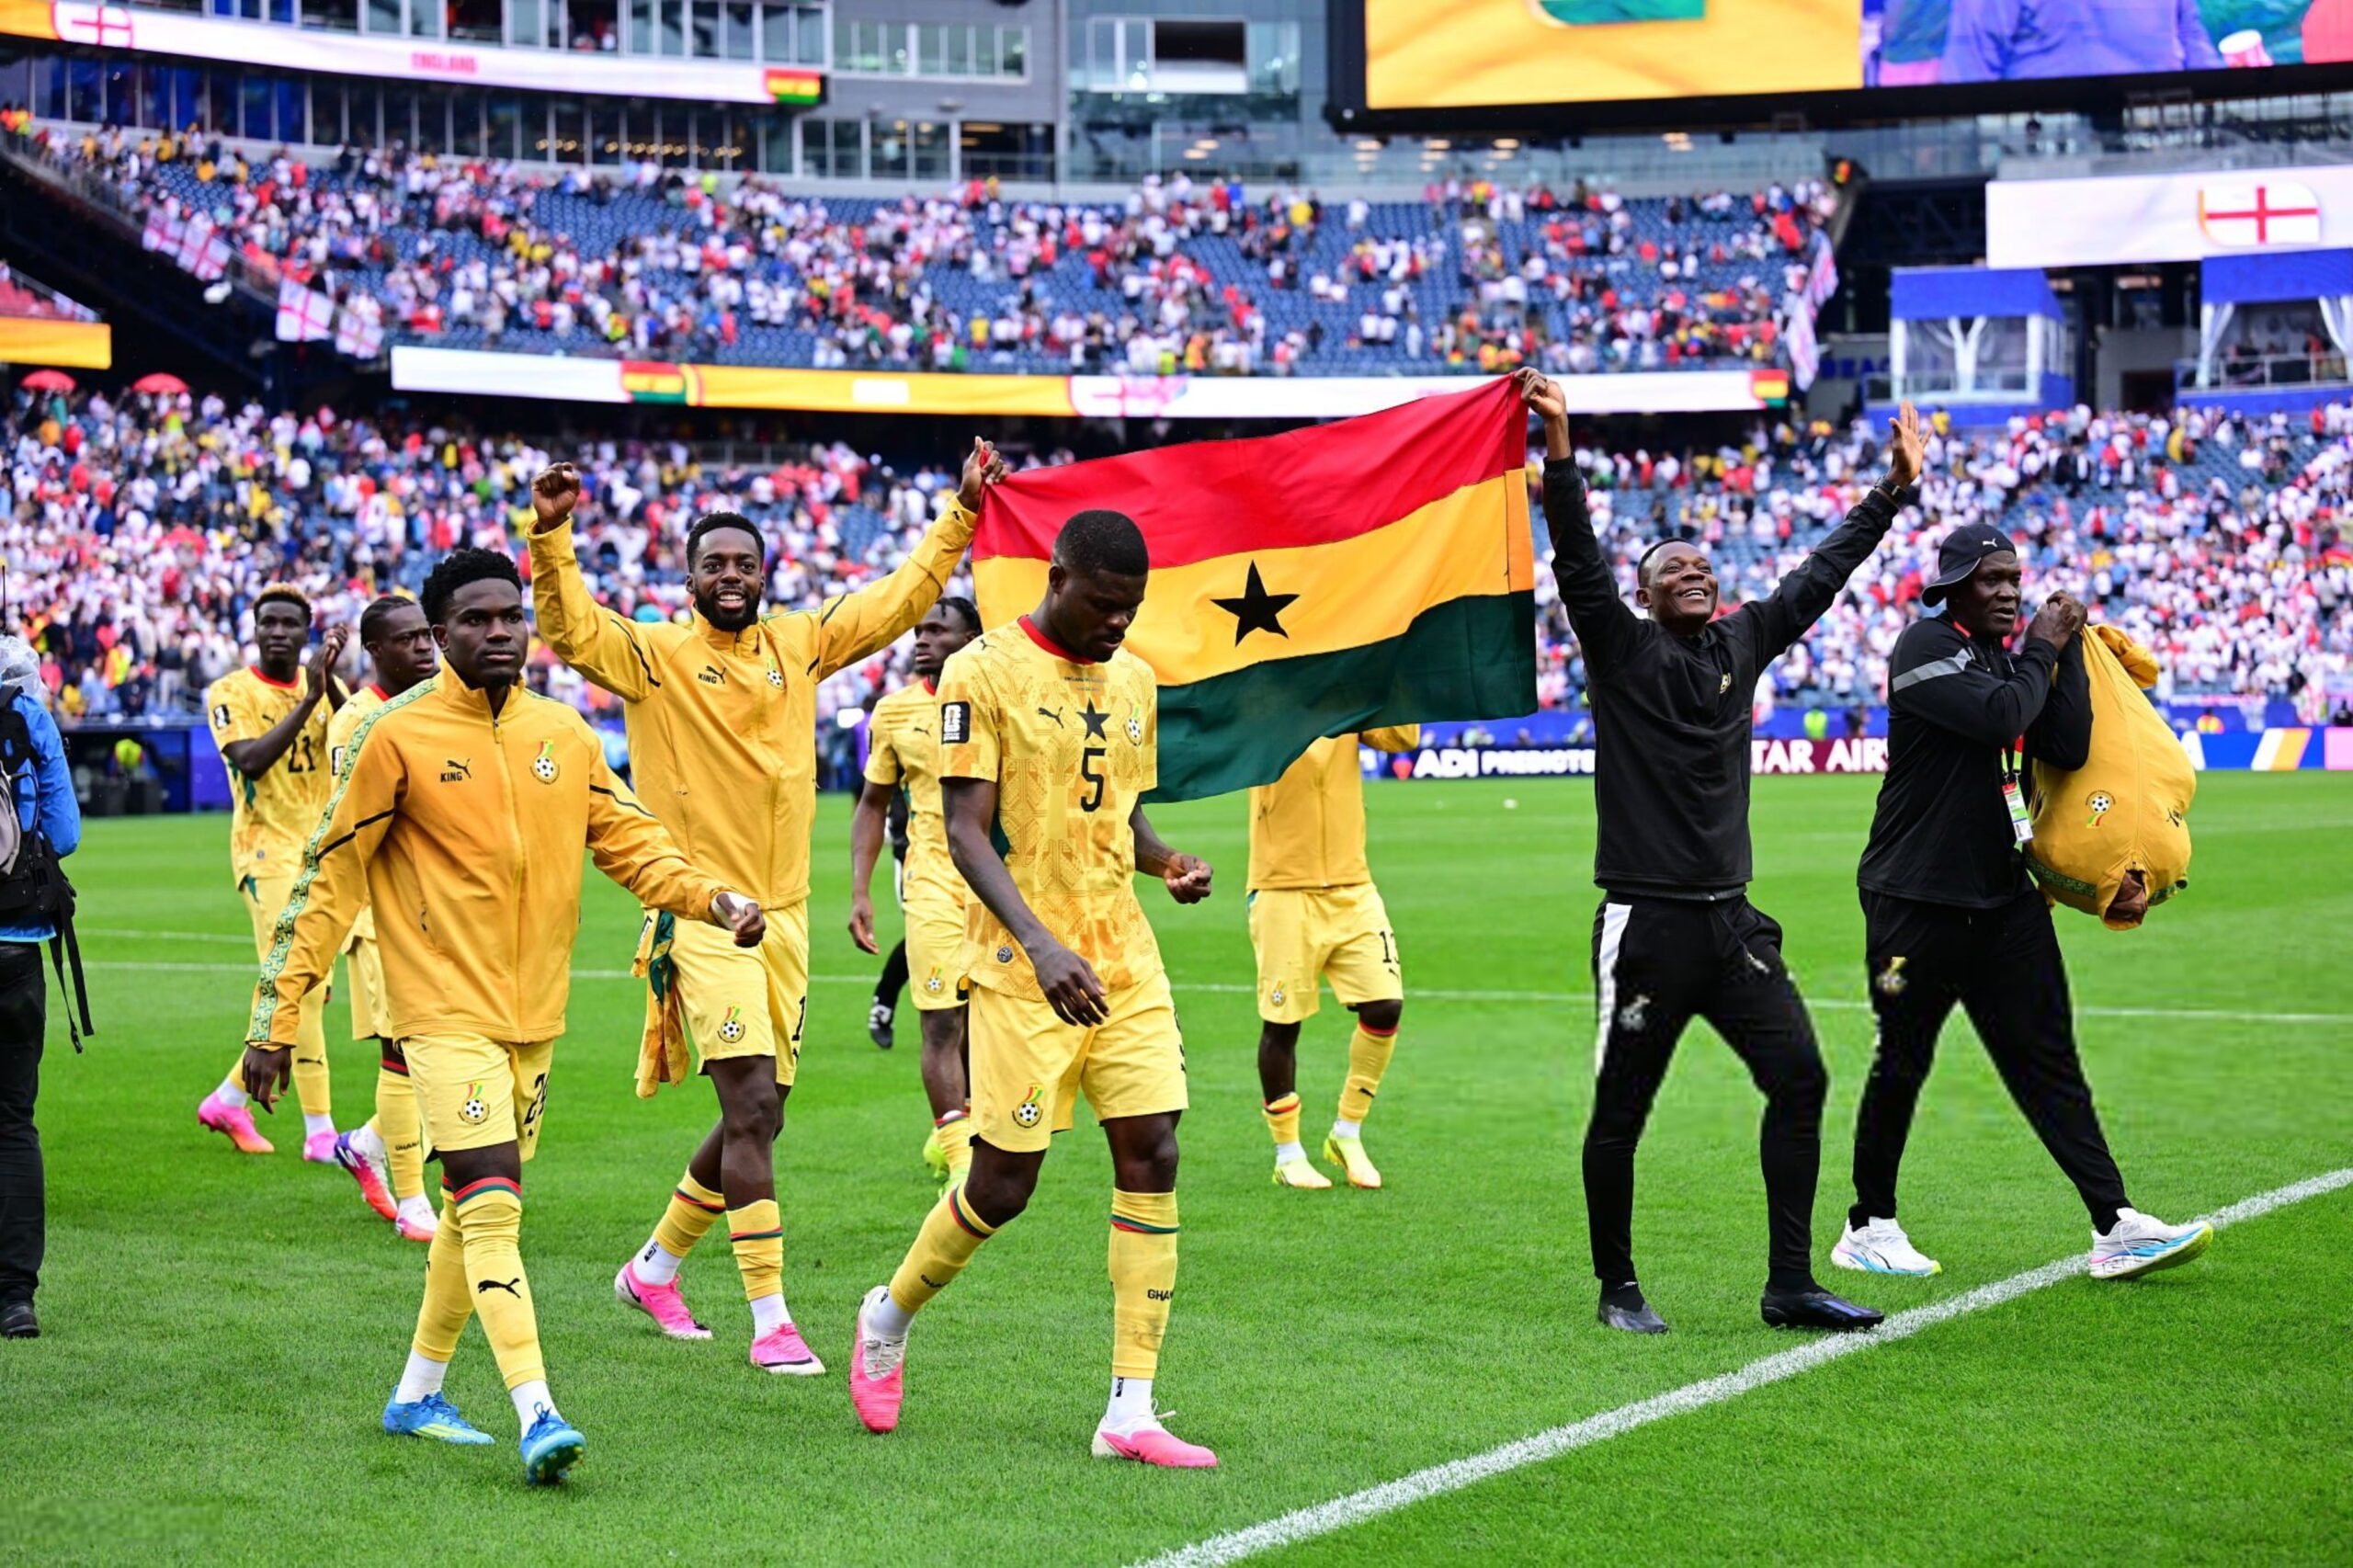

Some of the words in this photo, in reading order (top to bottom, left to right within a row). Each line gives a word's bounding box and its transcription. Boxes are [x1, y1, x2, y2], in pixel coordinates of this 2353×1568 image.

[698, 672, 717, 684] KING
[288, 734, 316, 773] 21
[1413, 747, 1479, 778] ADI
[1825, 738, 1889, 772] AIR
[440, 771, 462, 782] KING
[1080, 746, 1107, 812] 5
